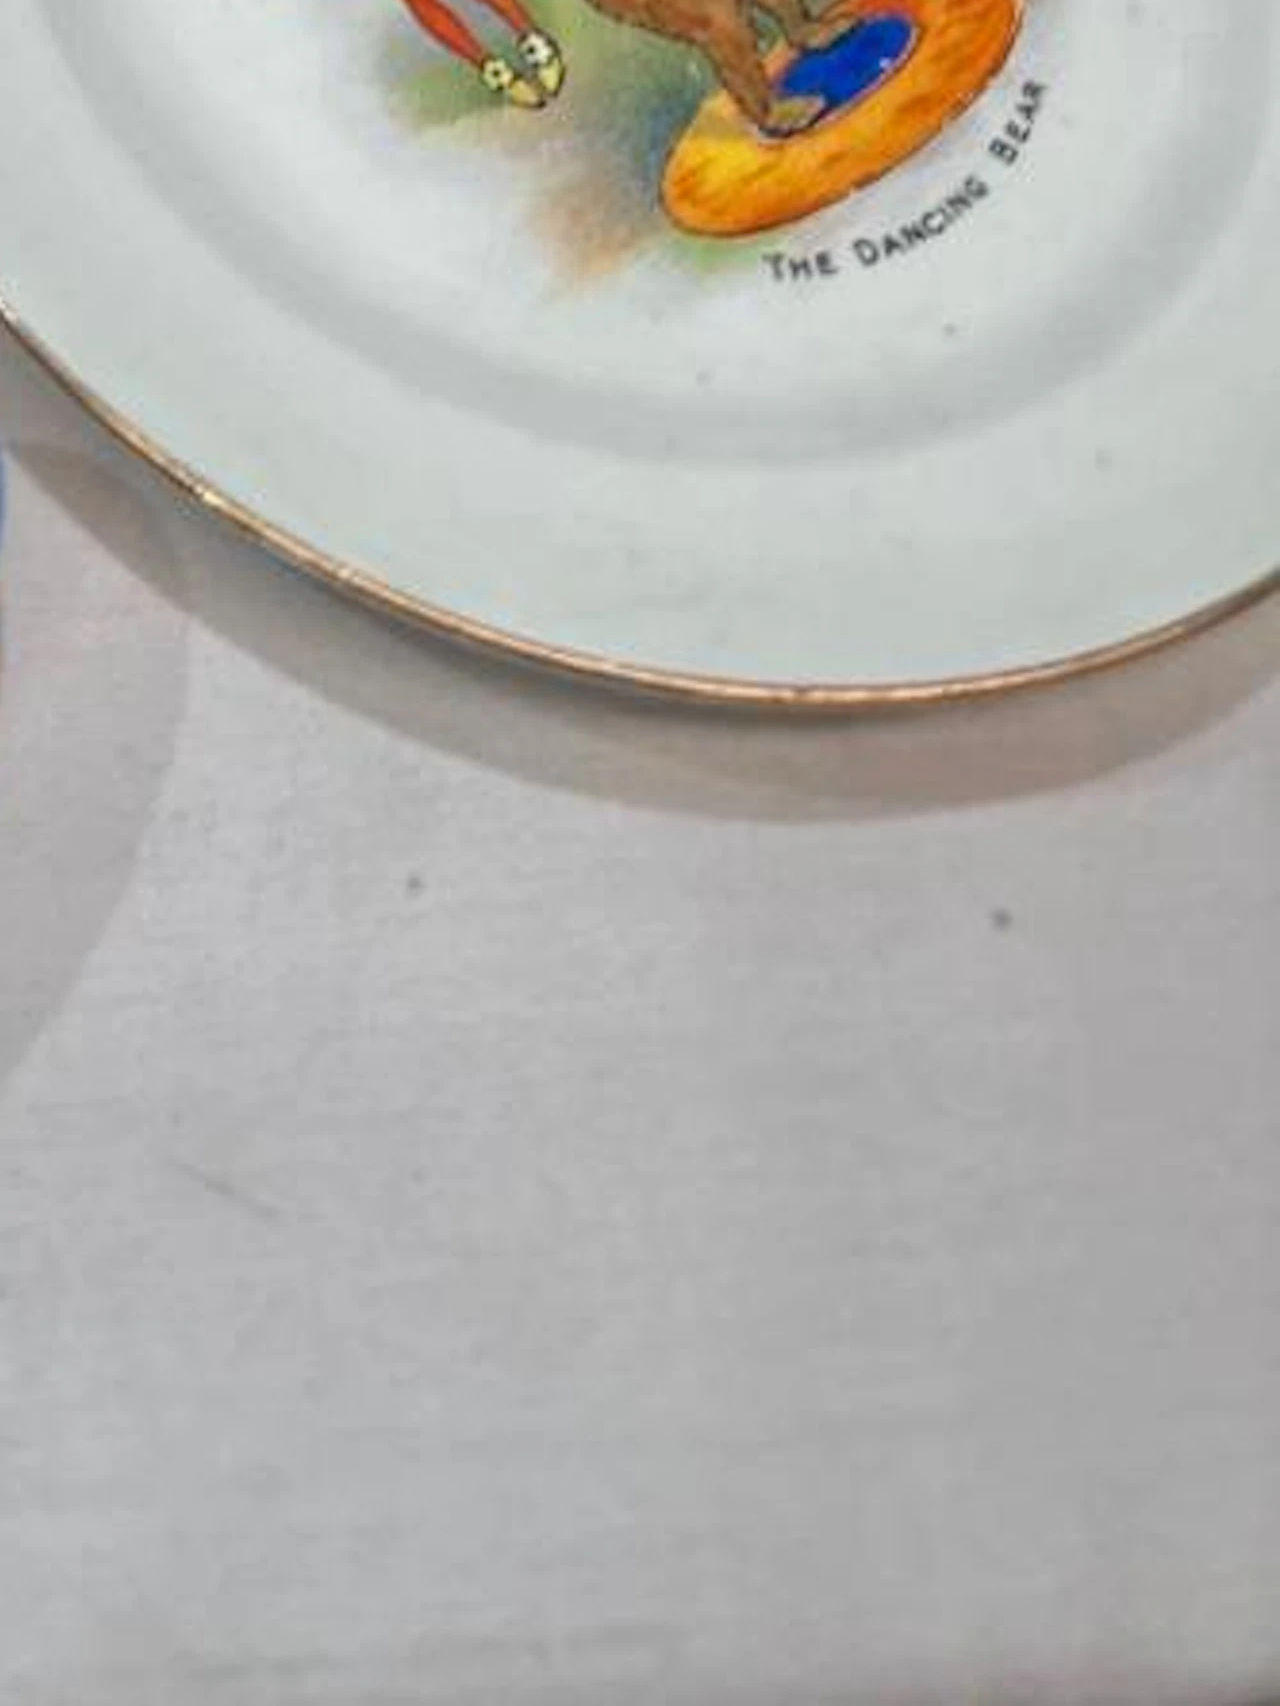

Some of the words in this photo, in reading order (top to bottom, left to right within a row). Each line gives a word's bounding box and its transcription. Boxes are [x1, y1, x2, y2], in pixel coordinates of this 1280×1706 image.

[761, 251, 838, 279] THE
[852, 175, 989, 265] DANCING
[988, 81, 1046, 165] BEAR
